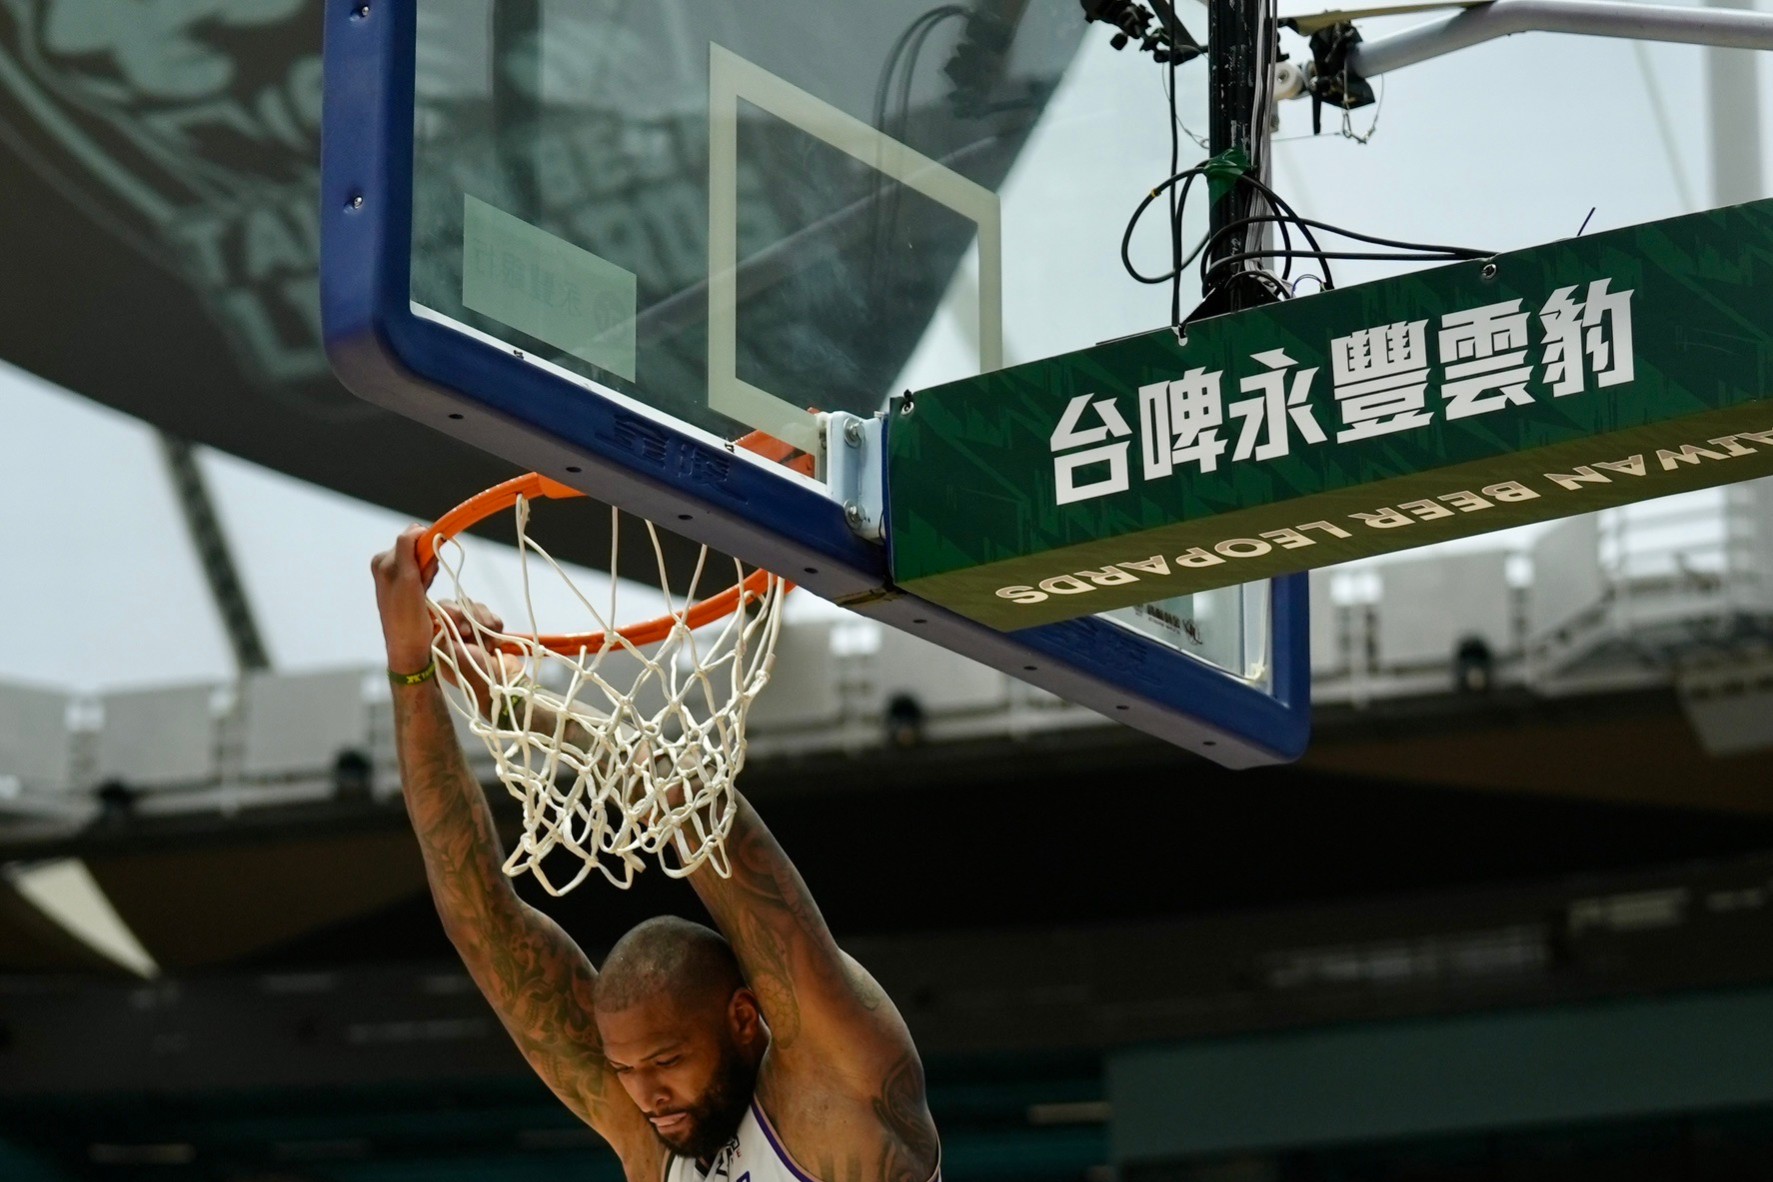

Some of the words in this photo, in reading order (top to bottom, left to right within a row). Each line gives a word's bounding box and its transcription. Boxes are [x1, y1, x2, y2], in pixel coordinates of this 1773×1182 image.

[1050, 277, 1637, 507] 台啤永豐雲豹
[1349, 480, 1542, 530] BEER
[995, 520, 1354, 604] LEOPARDS
